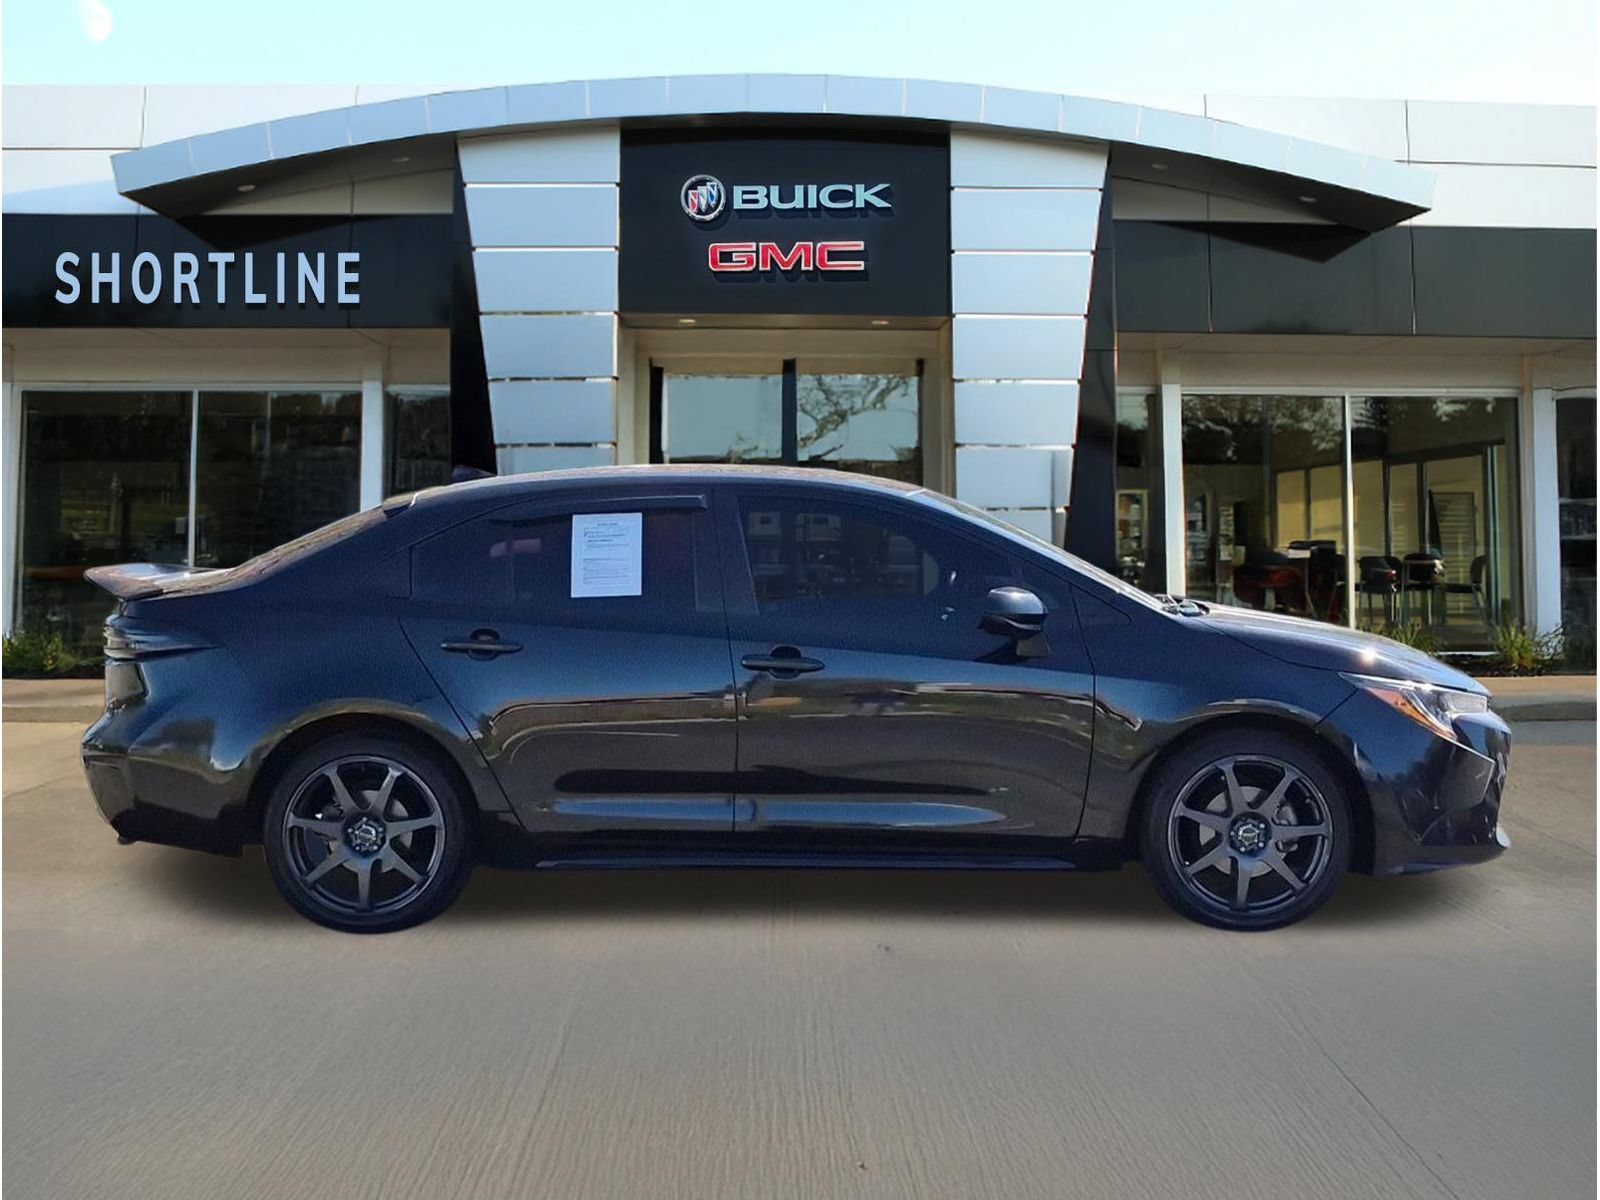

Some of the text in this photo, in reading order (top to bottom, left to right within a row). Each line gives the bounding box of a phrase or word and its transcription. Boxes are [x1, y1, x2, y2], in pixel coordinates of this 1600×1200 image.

[733, 184, 892, 209] BUICK
[708, 241, 864, 272] GMC
[55, 251, 360, 304] SHORTLINE
